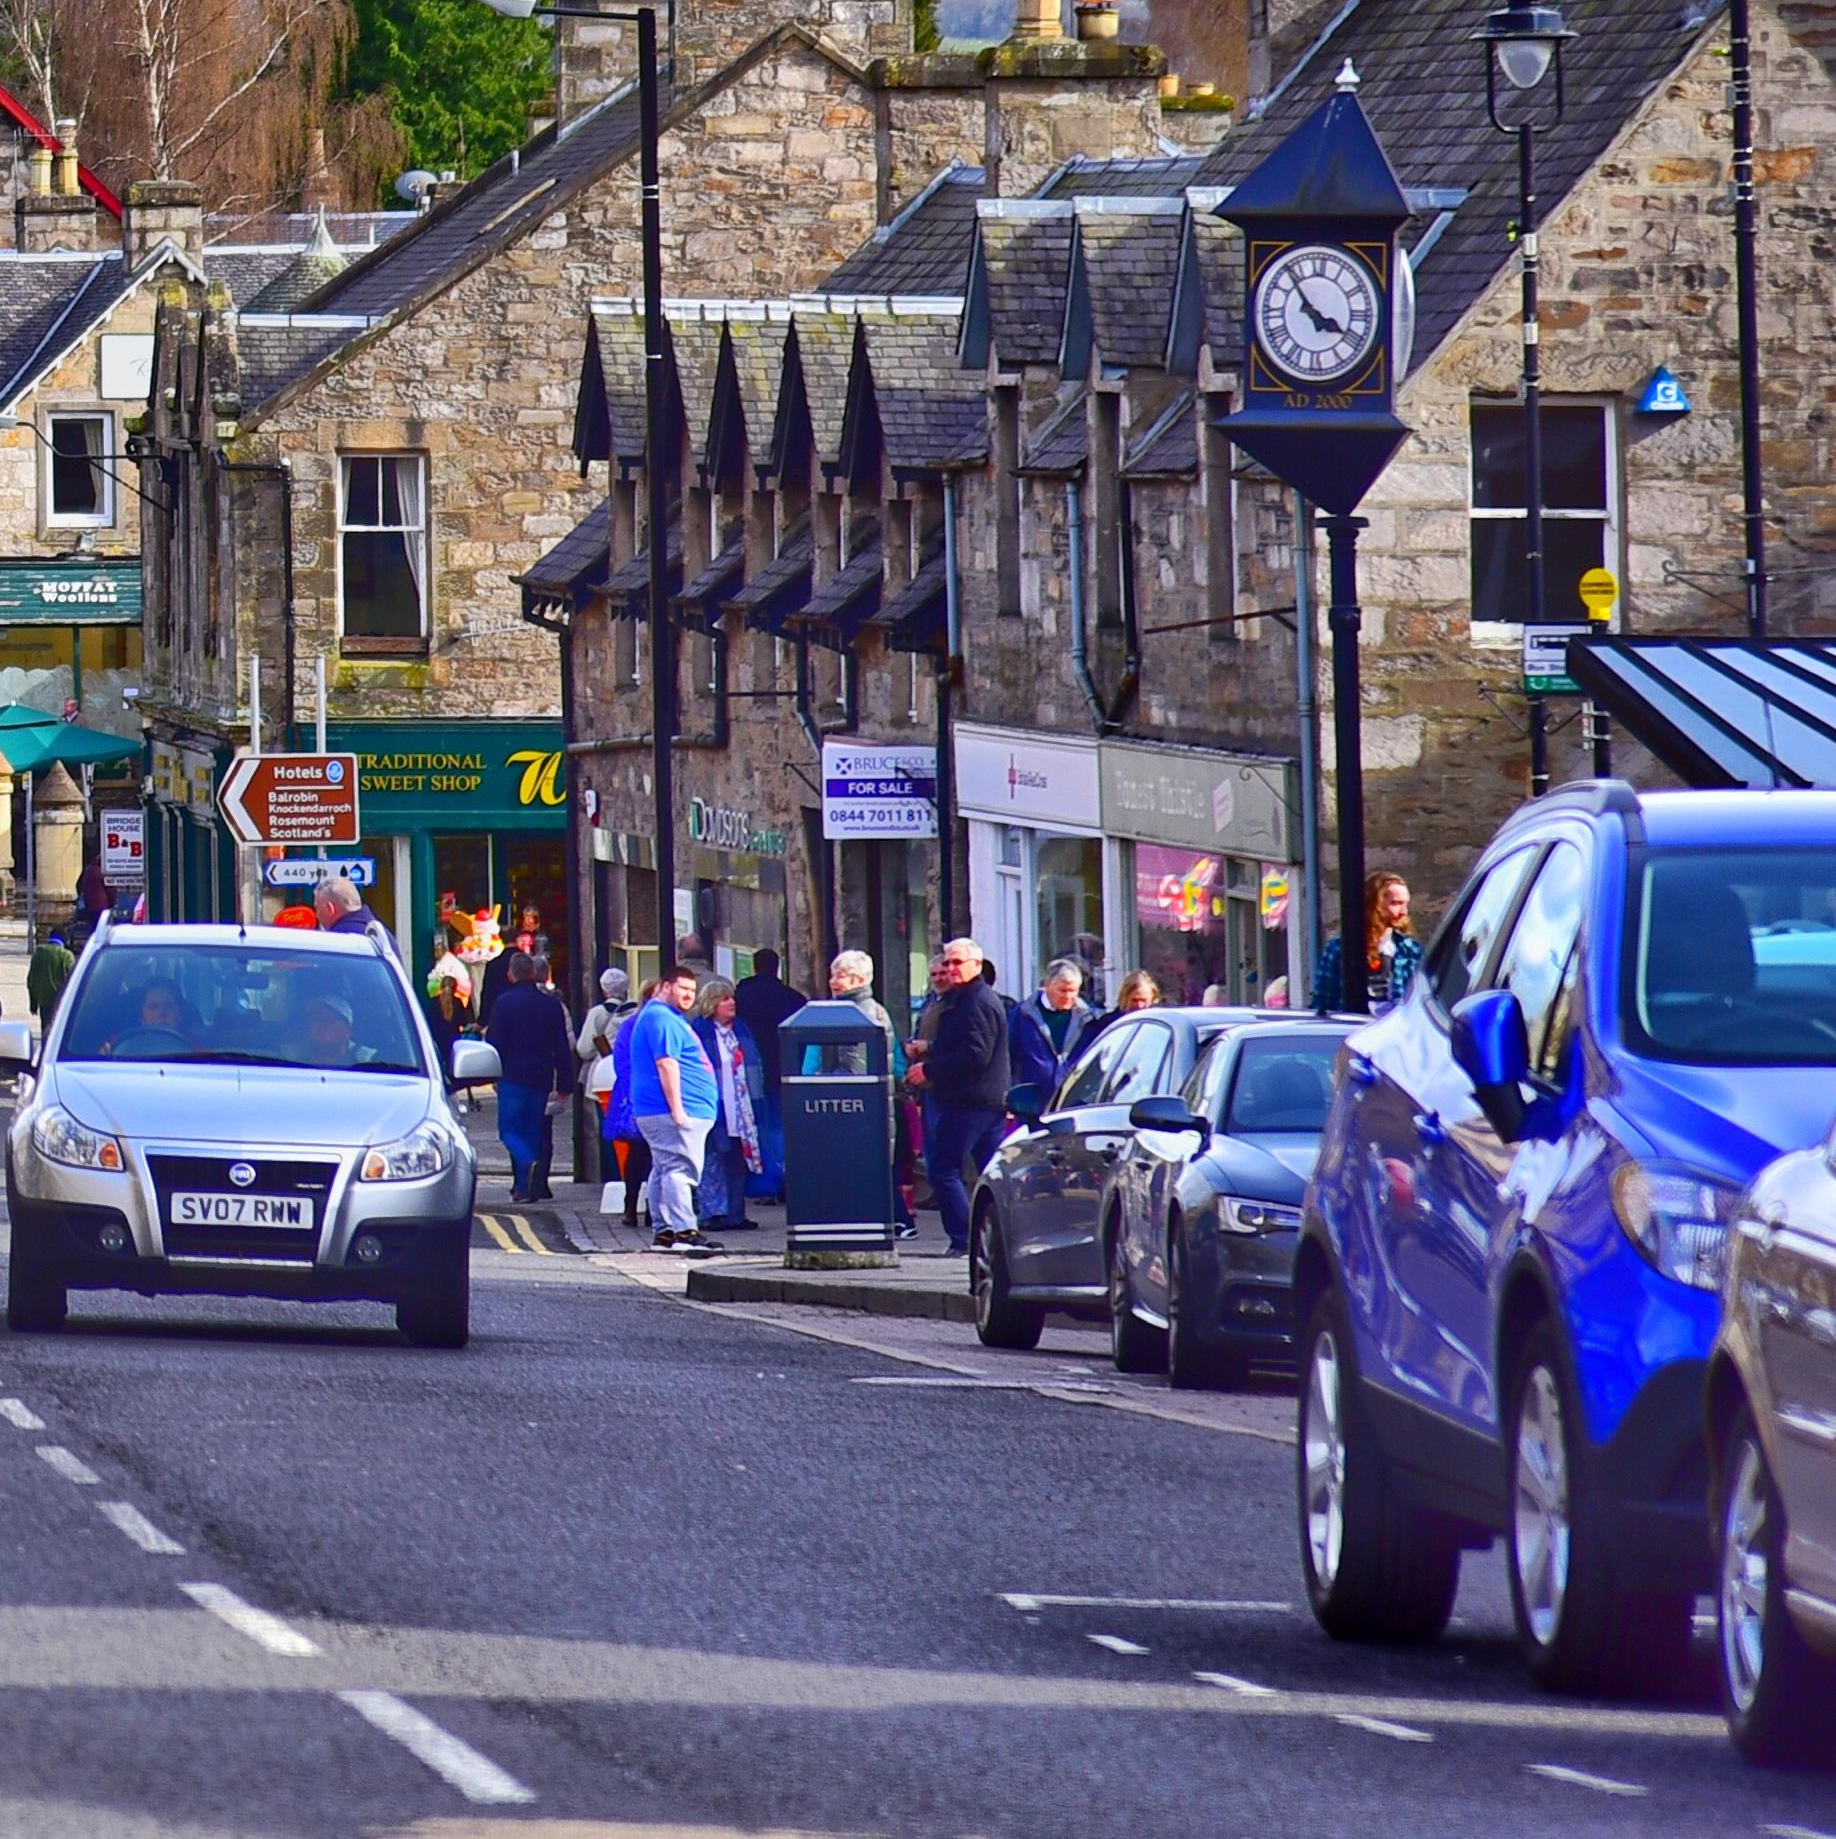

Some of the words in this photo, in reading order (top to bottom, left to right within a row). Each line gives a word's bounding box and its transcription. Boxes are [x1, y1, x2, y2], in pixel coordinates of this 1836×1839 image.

[1283, 393, 1309, 408] AD
[1315, 393, 1353, 409] 2000
[41, 581, 118, 593] MOFFAT
[41, 592, 118, 603] Woollens
[355, 753, 487, 770] TRADITIONAL
[273, 766, 323, 780] Hotels
[360, 775, 427, 791] SWEET
[430, 775, 482, 791] SHOP
[848, 782, 876, 795] FOR
[878, 782, 913, 795] SALE
[268, 791, 319, 803] Balrobin
[268, 803, 352, 813] Knockendarroch
[106, 817, 142, 825] BRIDGE
[269, 815, 335, 826] Rosemount
[829, 809, 865, 823] 0844
[869, 809, 902, 823] 7011
[269, 828, 332, 839] Scotland's
[283, 868, 306, 877] 440
[804, 1098, 865, 1113] LITTER
[182, 1197, 246, 1222] SV07
[254, 1199, 302, 1224] RWW
